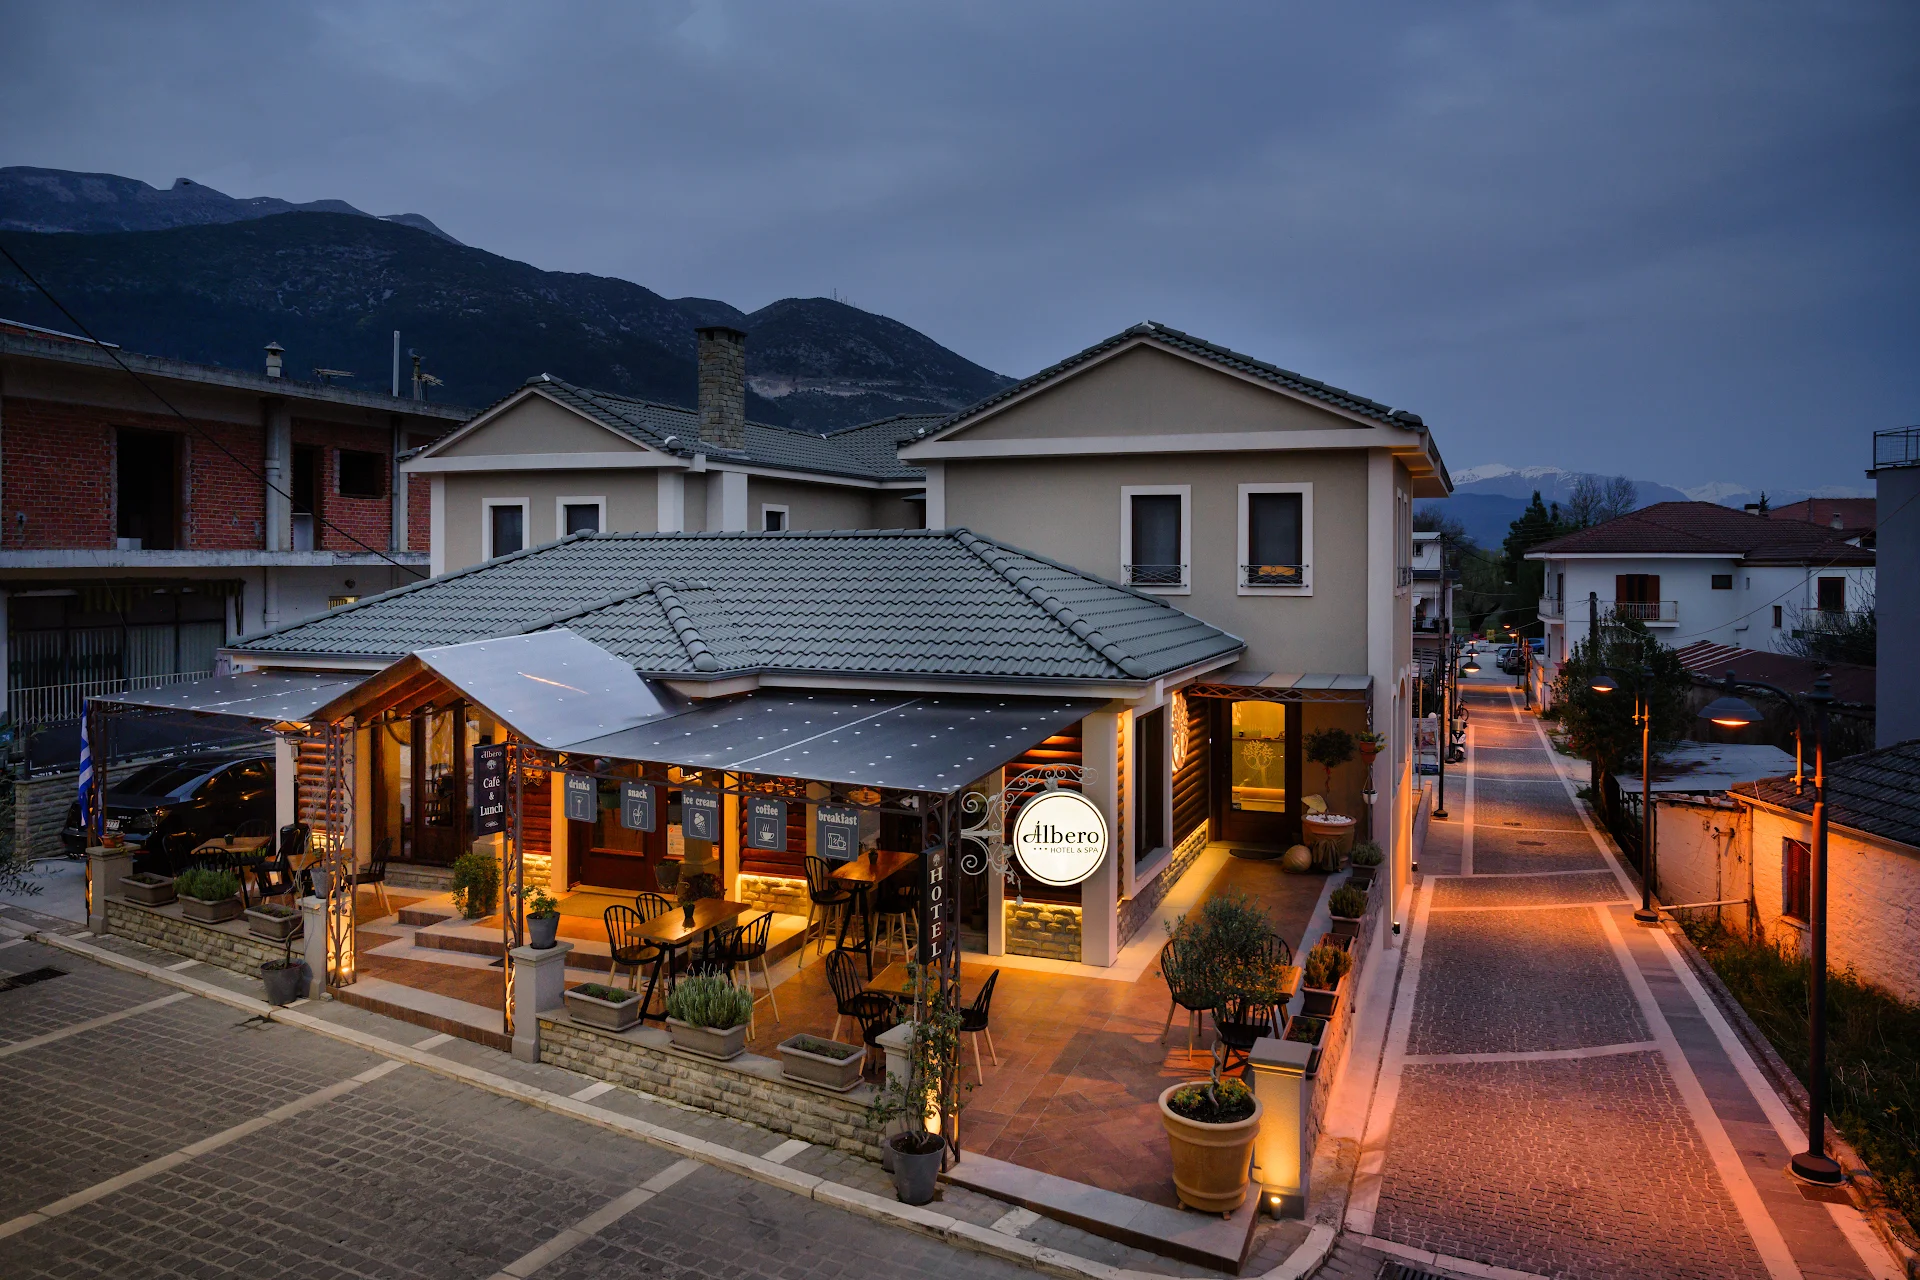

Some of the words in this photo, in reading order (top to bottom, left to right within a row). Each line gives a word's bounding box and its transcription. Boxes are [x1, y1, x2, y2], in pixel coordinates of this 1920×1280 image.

[483, 776, 501, 788] Café
[569, 779, 590, 791] drinks
[489, 791, 495, 801] &
[627, 788, 648, 800] snack
[683, 794, 694, 805] ice
[696, 797, 717, 808] cream
[480, 803, 504, 817] Lunch
[755, 804, 779, 816] coffee
[818, 810, 858, 826] breakfast
[929, 865, 944, 959] HOTEL
